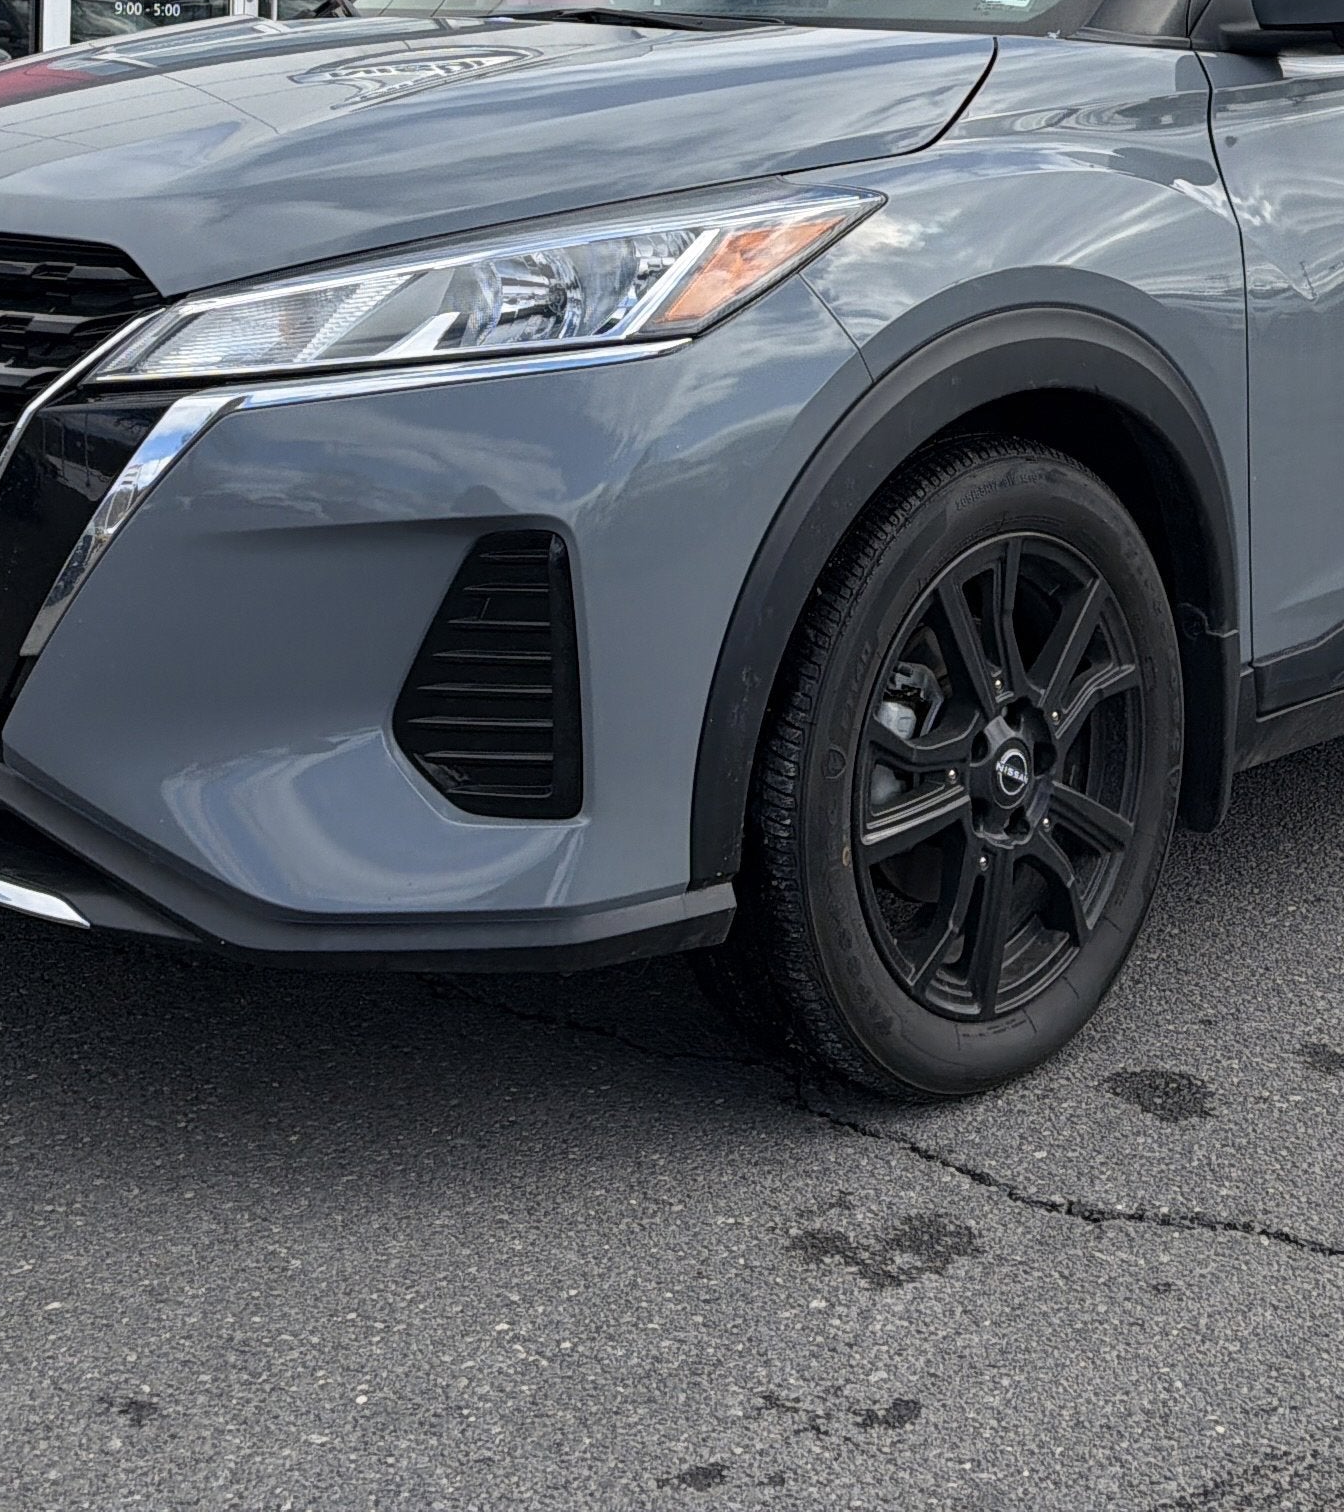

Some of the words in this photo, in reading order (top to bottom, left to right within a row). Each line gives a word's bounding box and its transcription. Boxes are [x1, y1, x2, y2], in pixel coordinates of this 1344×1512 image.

[114, 1, 142, 16] 9:00
[153, 3, 181, 18] 5:00
[996, 761, 1028, 784] NISSAN
